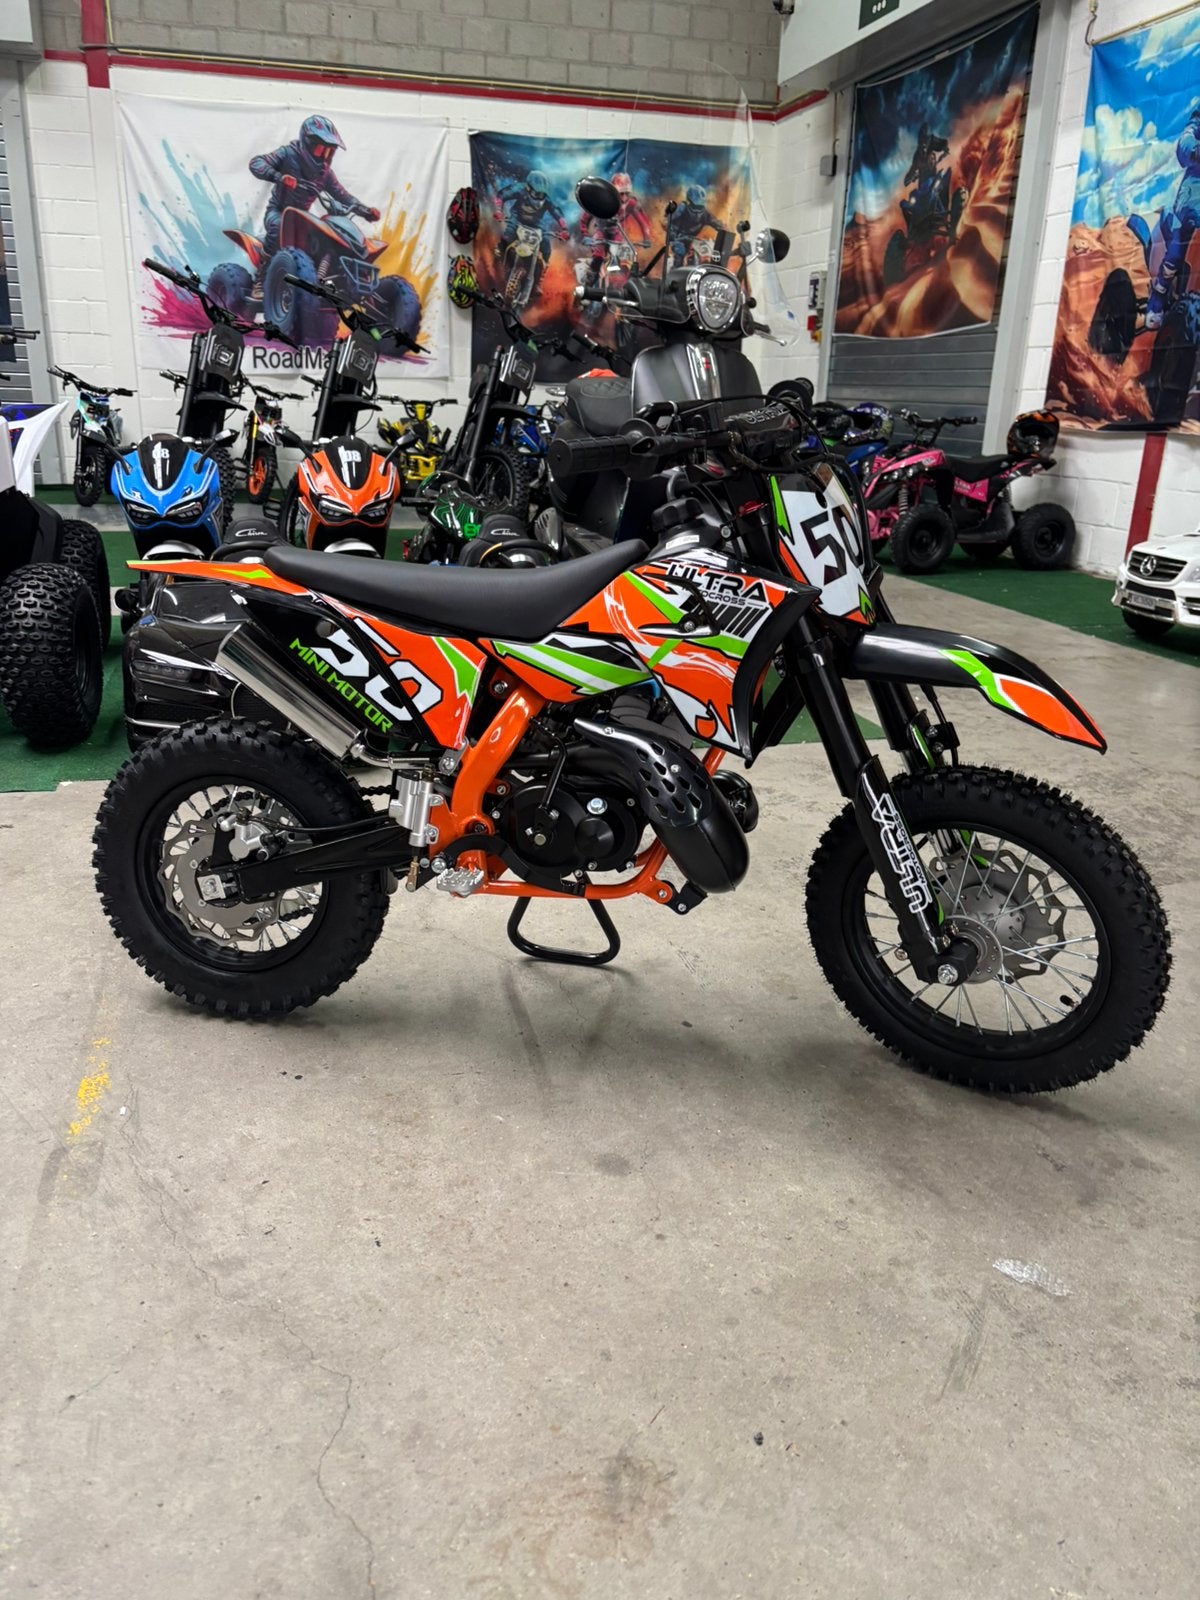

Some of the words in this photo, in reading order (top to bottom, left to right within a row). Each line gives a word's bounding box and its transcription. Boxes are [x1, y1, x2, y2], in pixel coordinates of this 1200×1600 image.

[252, 345, 332, 370] RoadMa
[668, 563, 768, 603] ULTRA
[800, 505, 864, 586] 50
[289, 638, 330, 678] MINI
[327, 671, 393, 733] MOTOR
[311, 617, 442, 721] 50
[872, 793, 931, 914] ULTRA
[894, 812, 926, 884] MOTOCROSS
